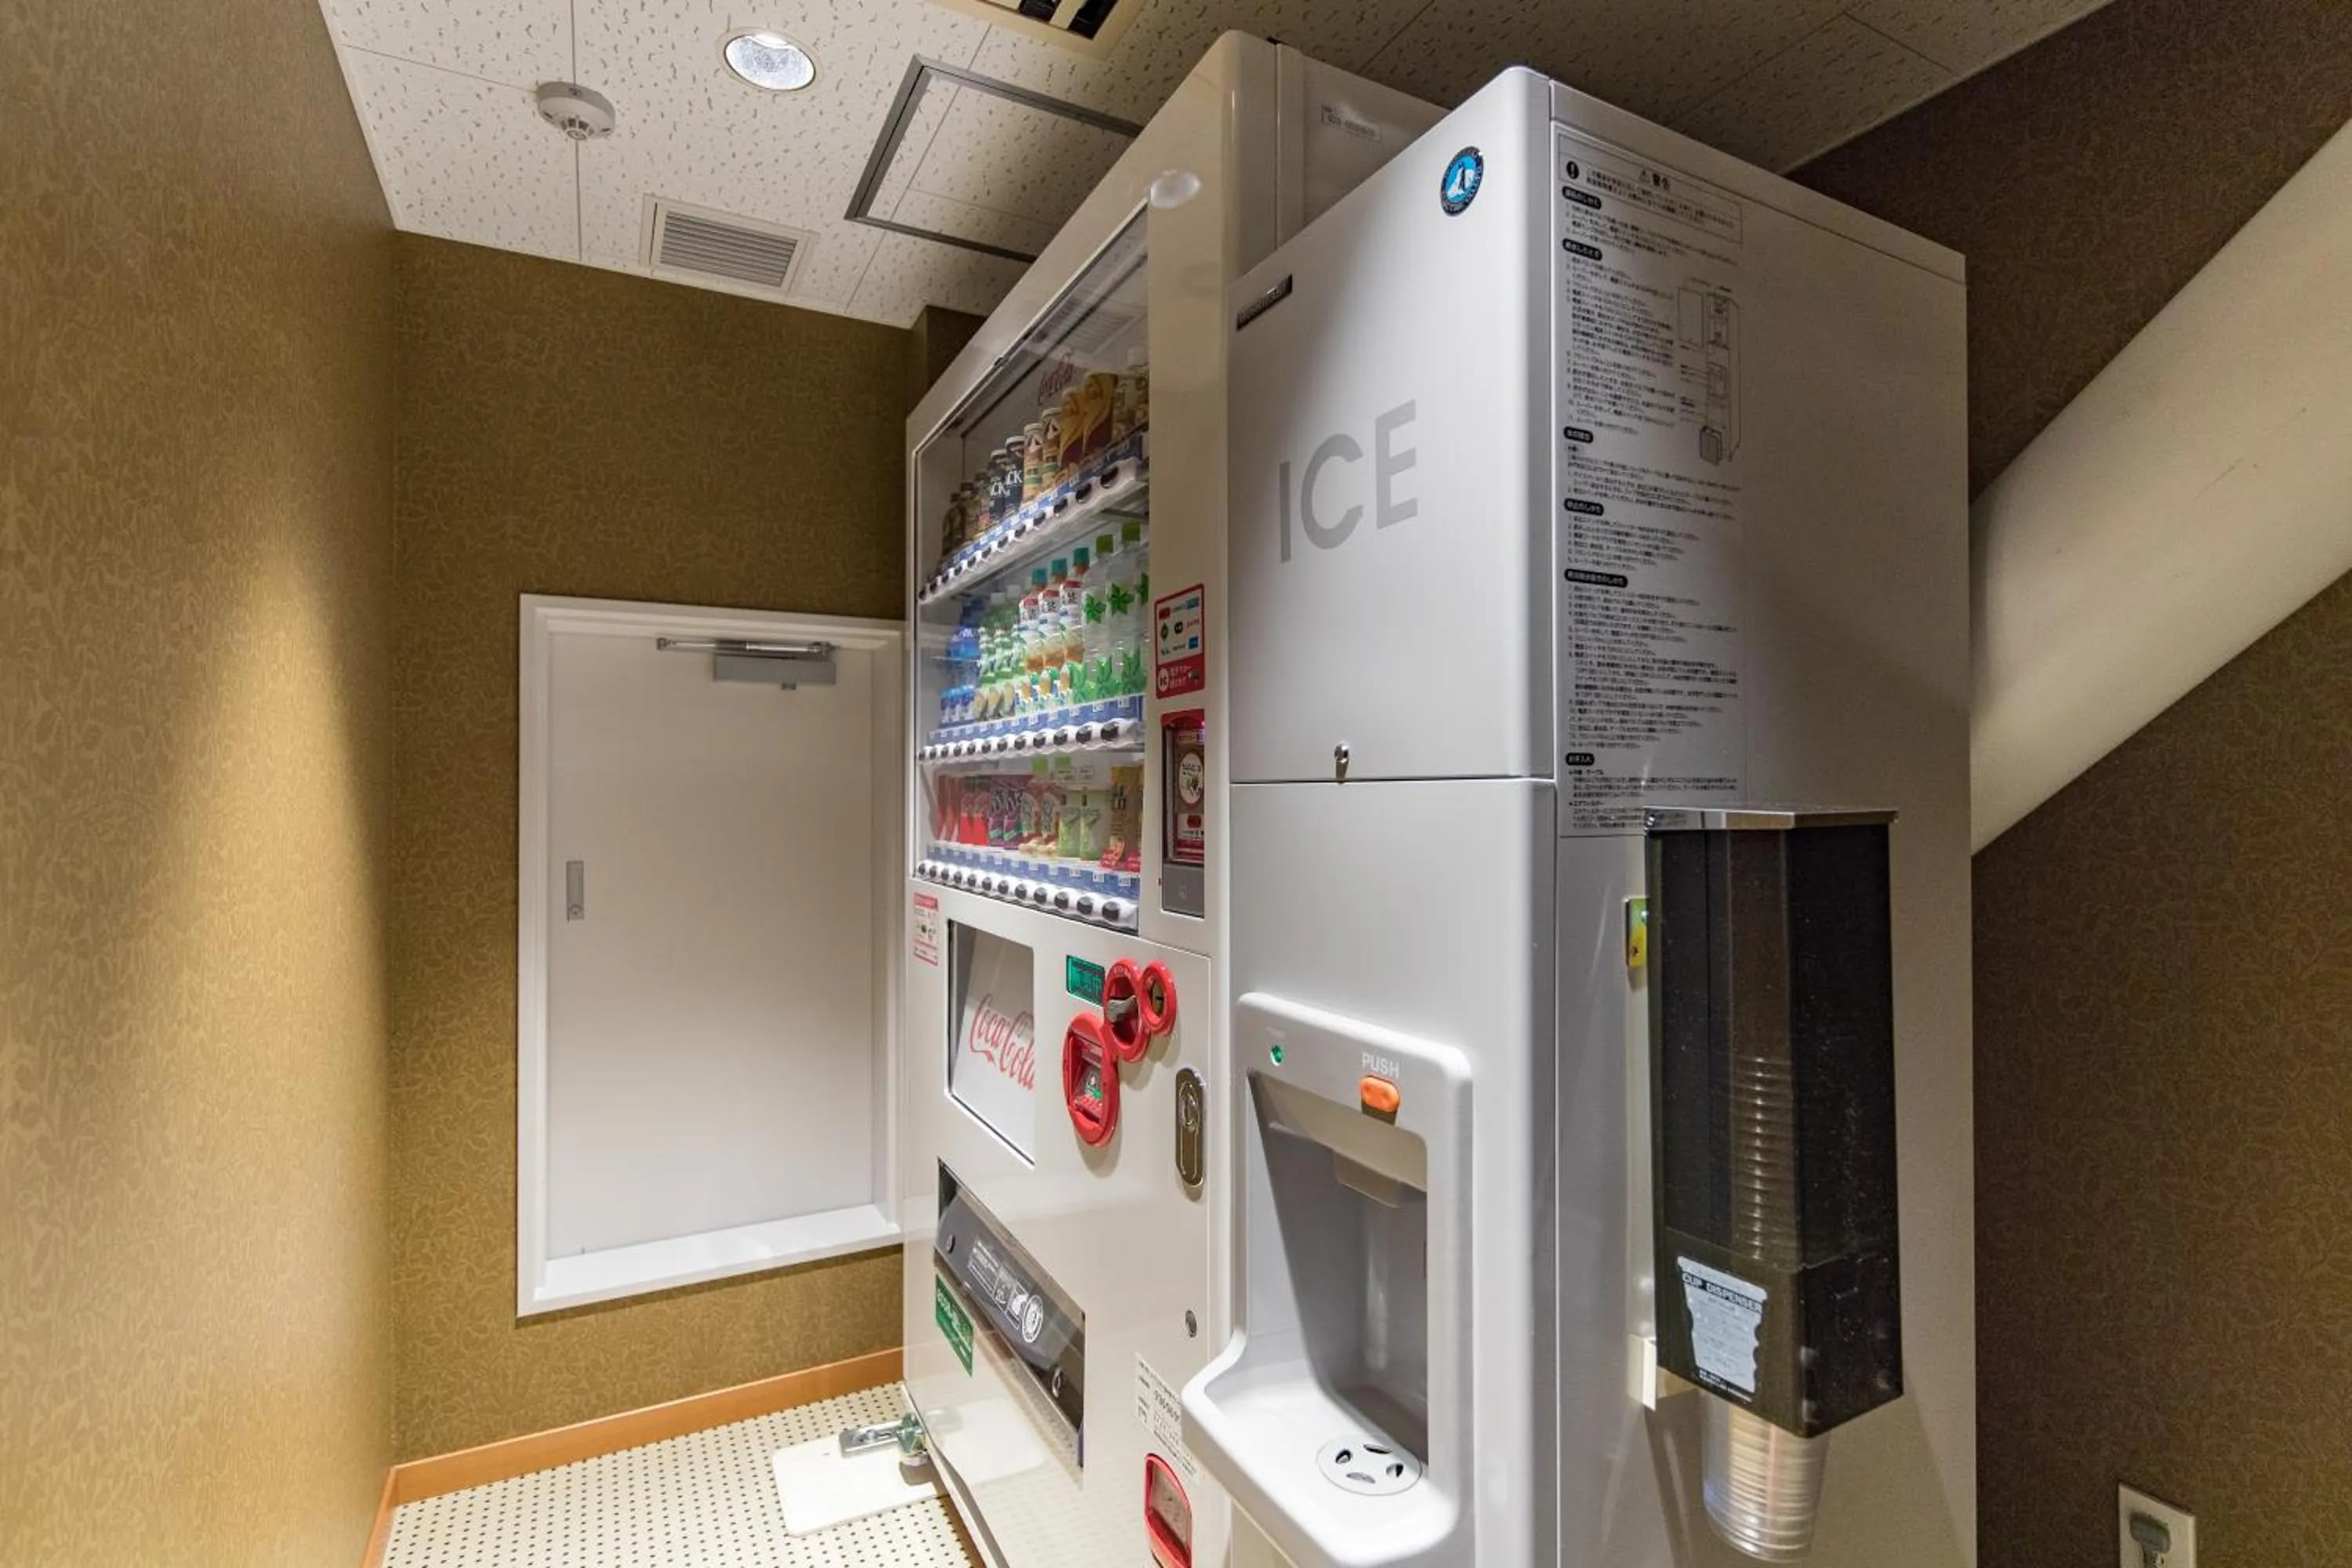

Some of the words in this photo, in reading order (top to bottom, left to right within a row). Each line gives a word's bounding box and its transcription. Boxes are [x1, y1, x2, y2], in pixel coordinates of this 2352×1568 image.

[1279, 398, 1418, 564] ICE
[1361, 1052, 1400, 1079] PUSH
[1682, 1272, 1702, 1287] CUP
[1706, 1281, 1762, 1314] DISPENSER
